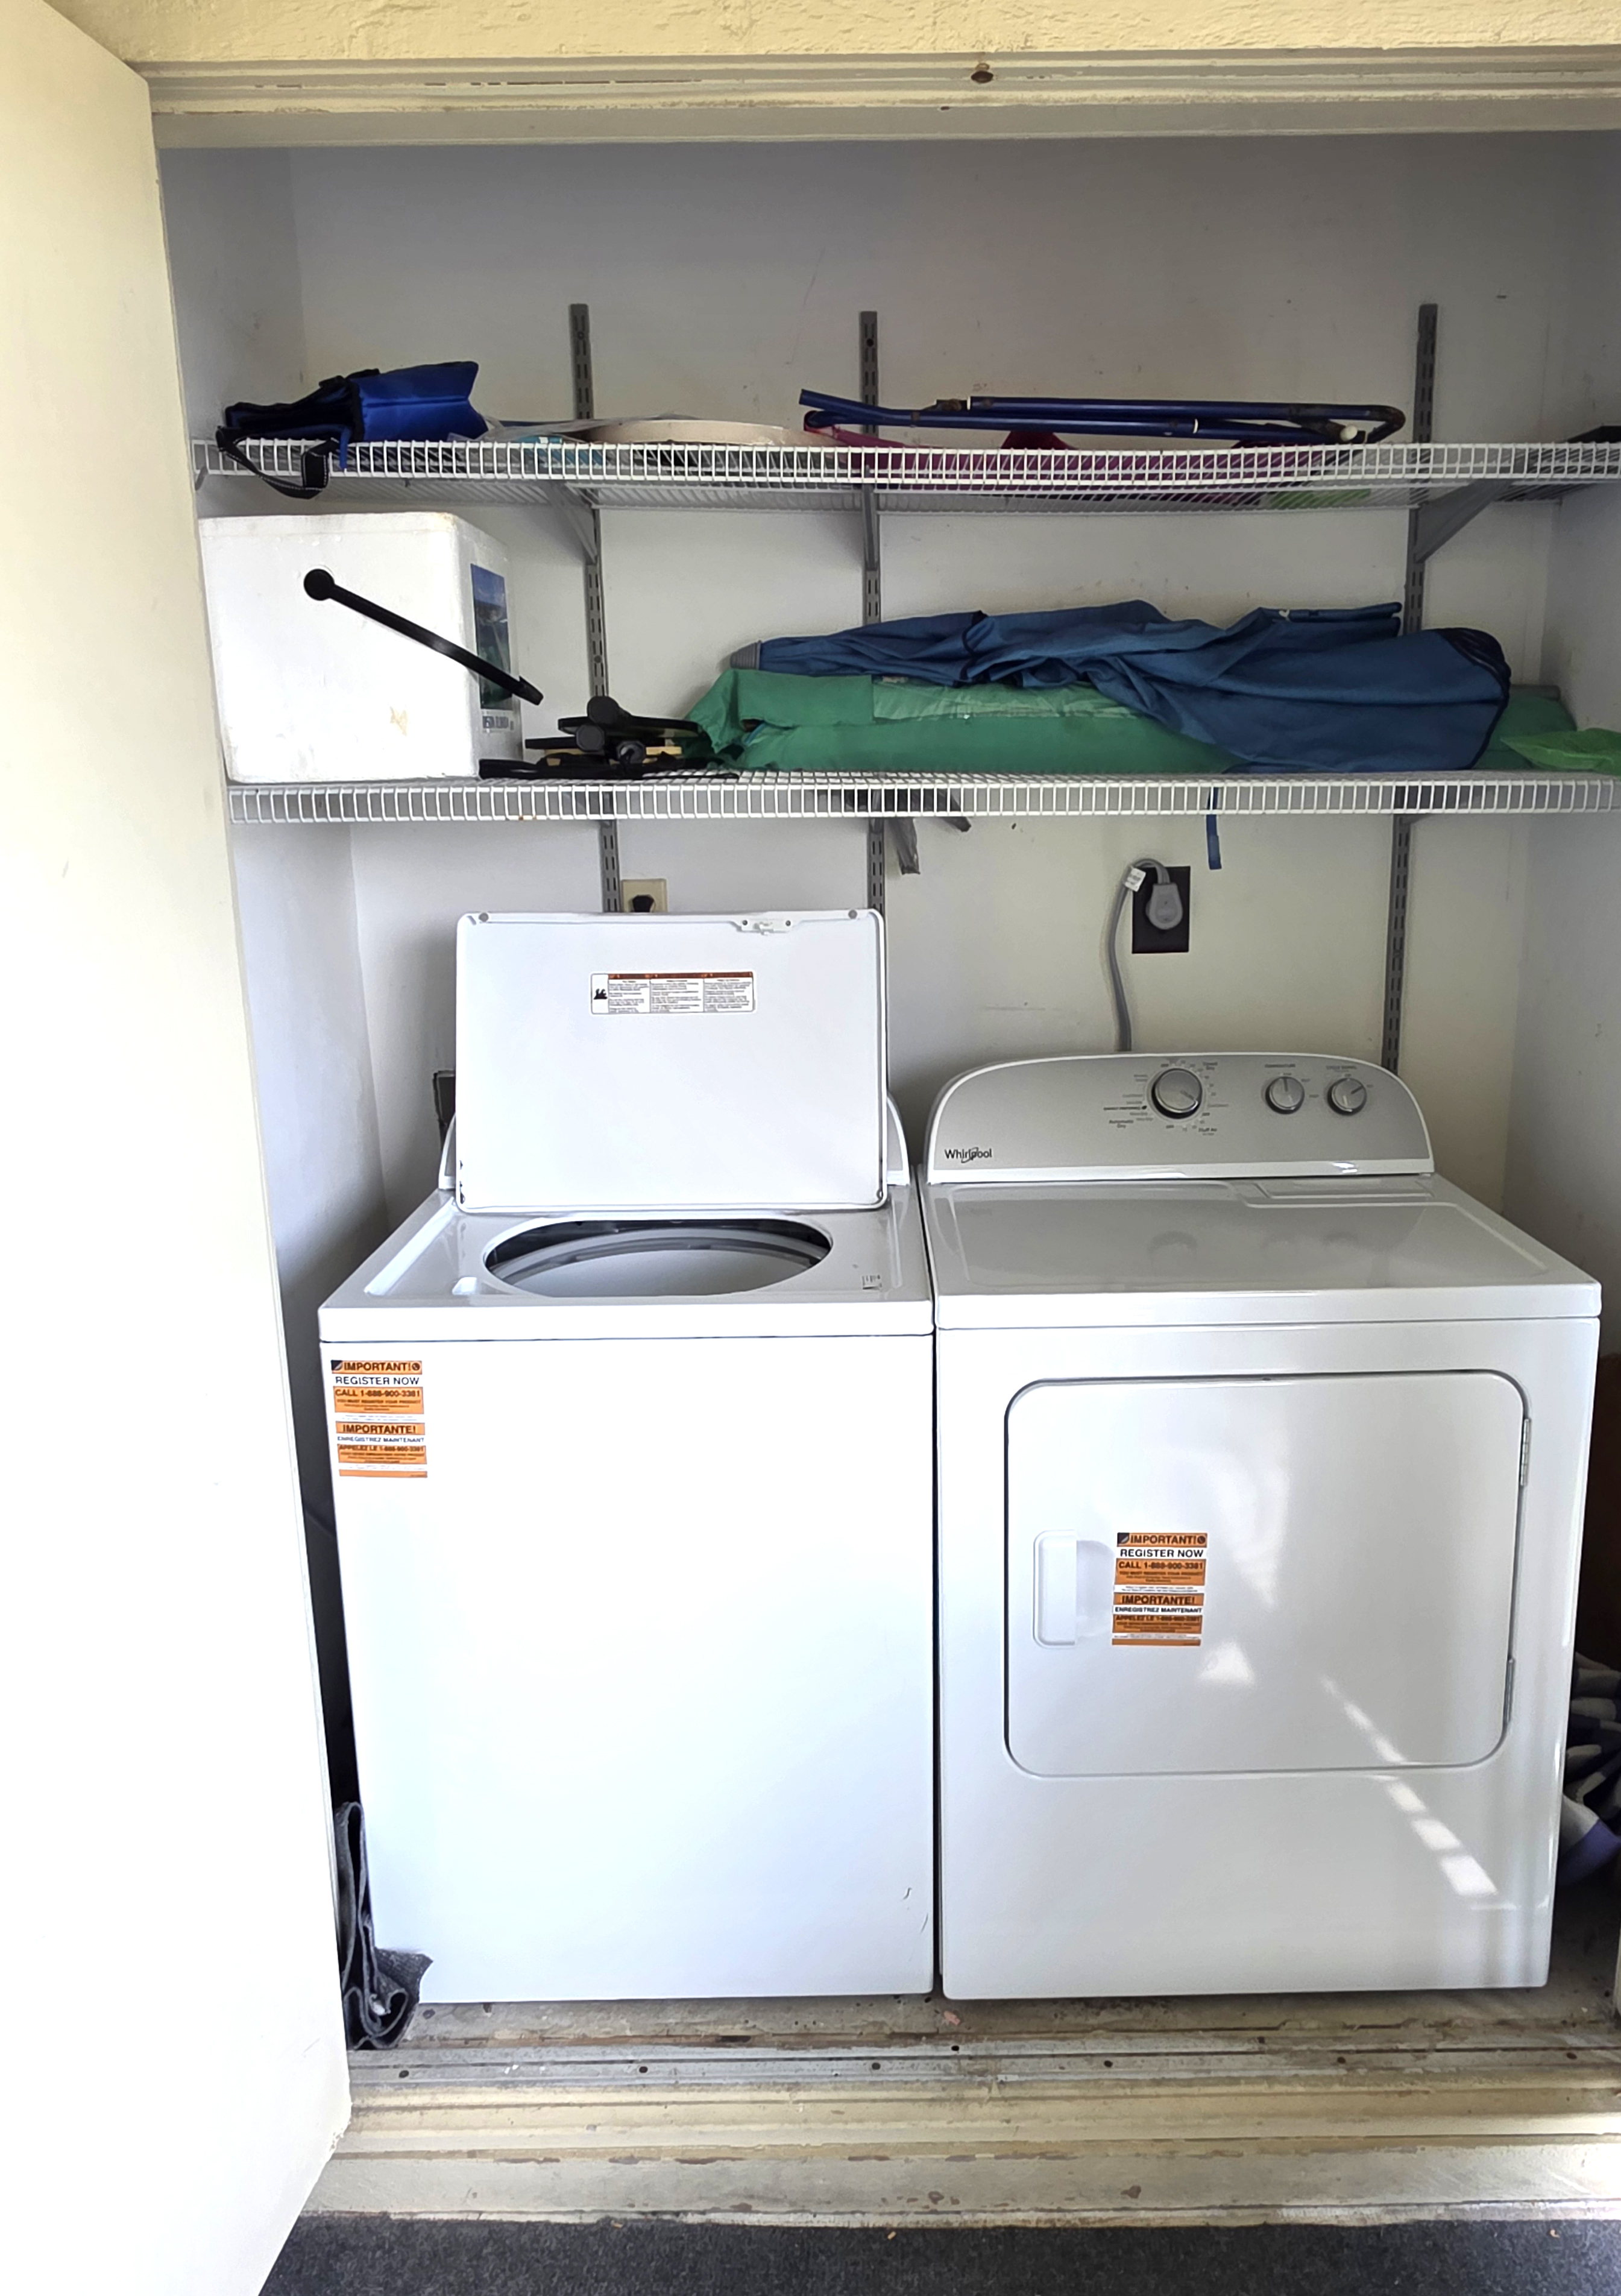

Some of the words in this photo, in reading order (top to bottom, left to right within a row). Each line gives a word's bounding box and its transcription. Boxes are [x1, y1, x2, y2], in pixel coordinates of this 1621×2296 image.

[944, 1148, 992, 1162] Whirlpool
[344, 1362, 411, 1370] IMPORTANT!
[342, 1424, 416, 1434] IMPORTANTE!
[1130, 1535, 1196, 1544] IMPORTANT!
[1122, 1595, 1195, 1604] IMPORTANTE!
